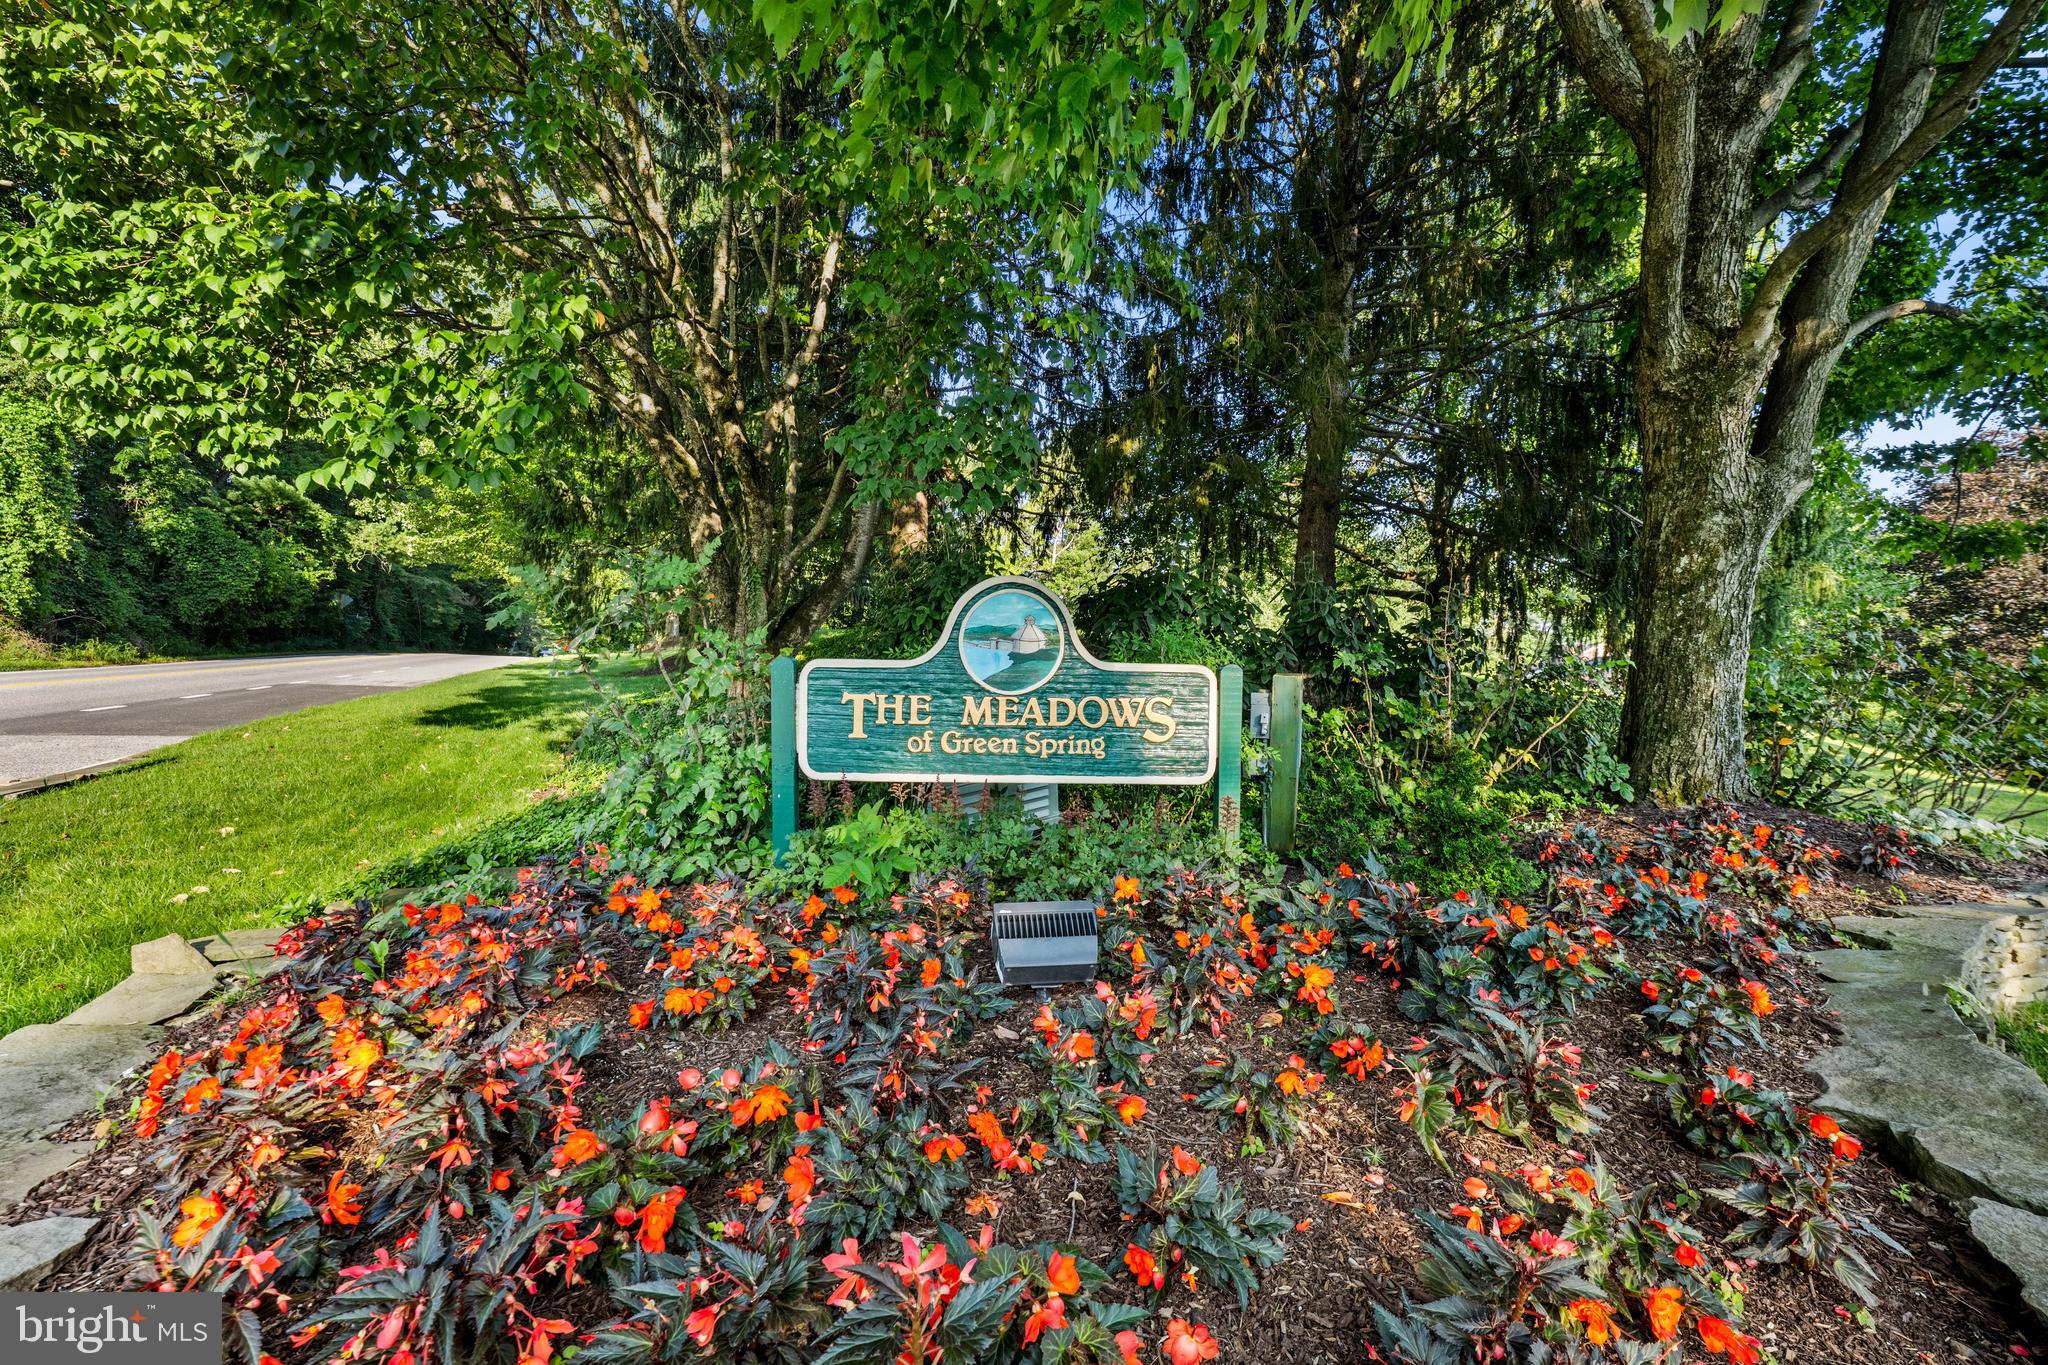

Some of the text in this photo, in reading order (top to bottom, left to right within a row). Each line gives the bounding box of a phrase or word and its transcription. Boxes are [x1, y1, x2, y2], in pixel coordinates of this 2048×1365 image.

[841, 691, 1177, 743] THE MEADOWS
[907, 731, 1106, 760] of Green Spring
